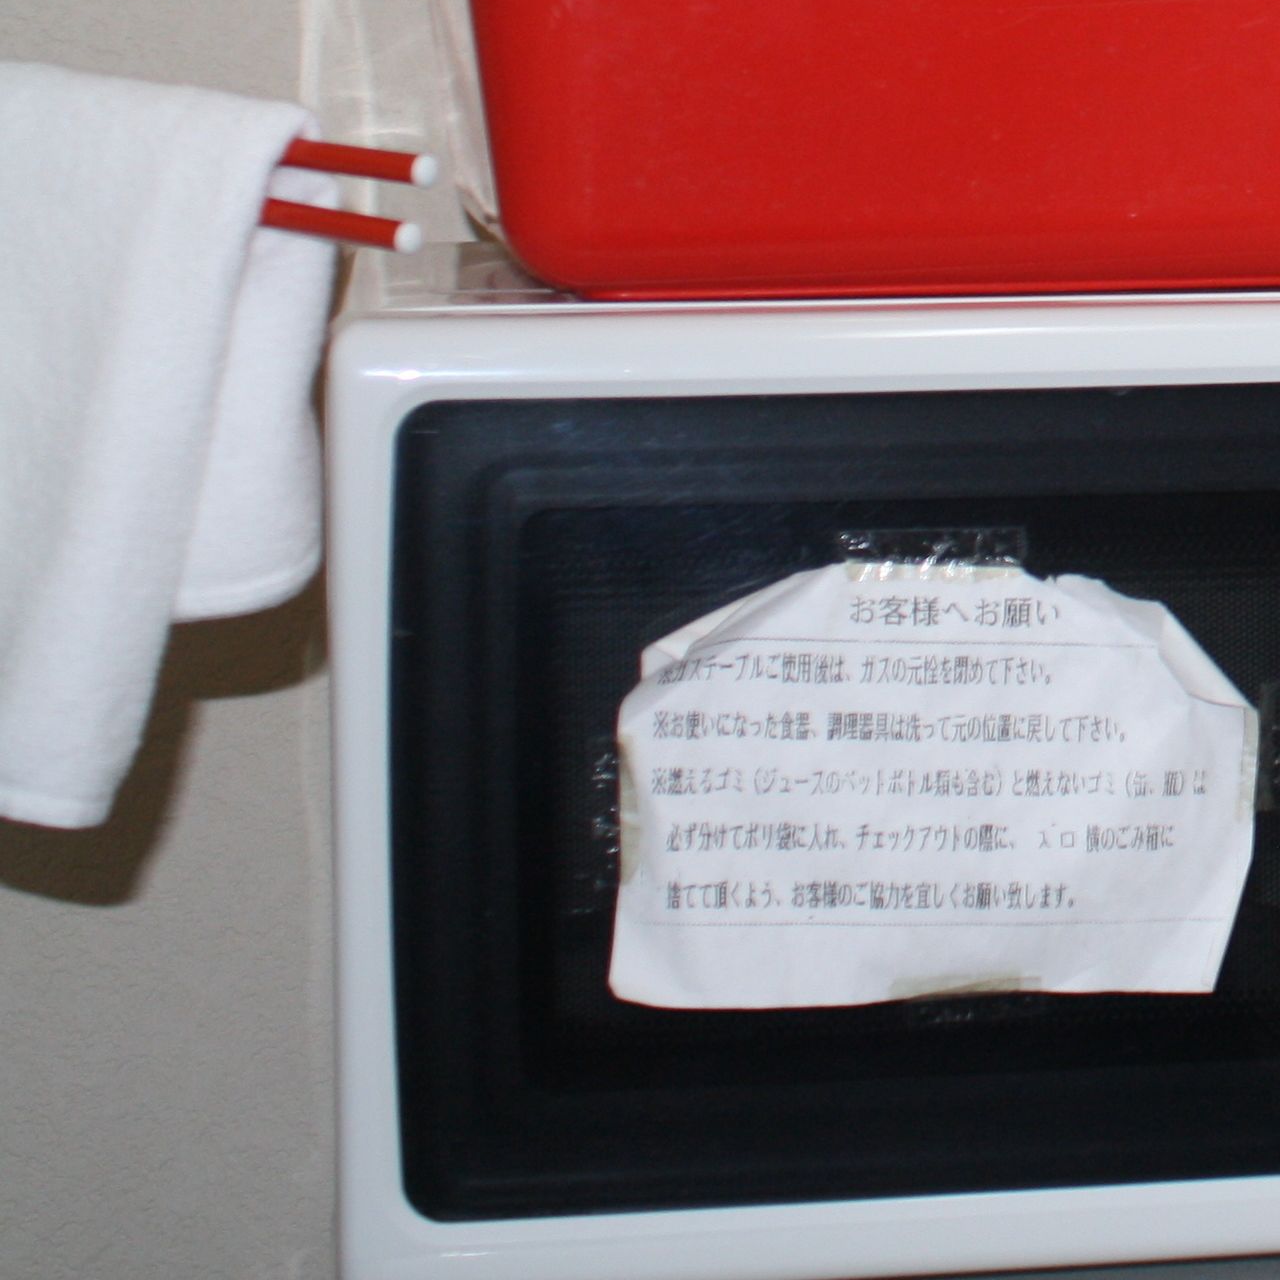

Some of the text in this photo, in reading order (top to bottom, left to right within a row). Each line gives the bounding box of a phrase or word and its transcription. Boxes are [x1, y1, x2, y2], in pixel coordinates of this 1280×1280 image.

[850, 595, 1059, 626] お客様へお願い
